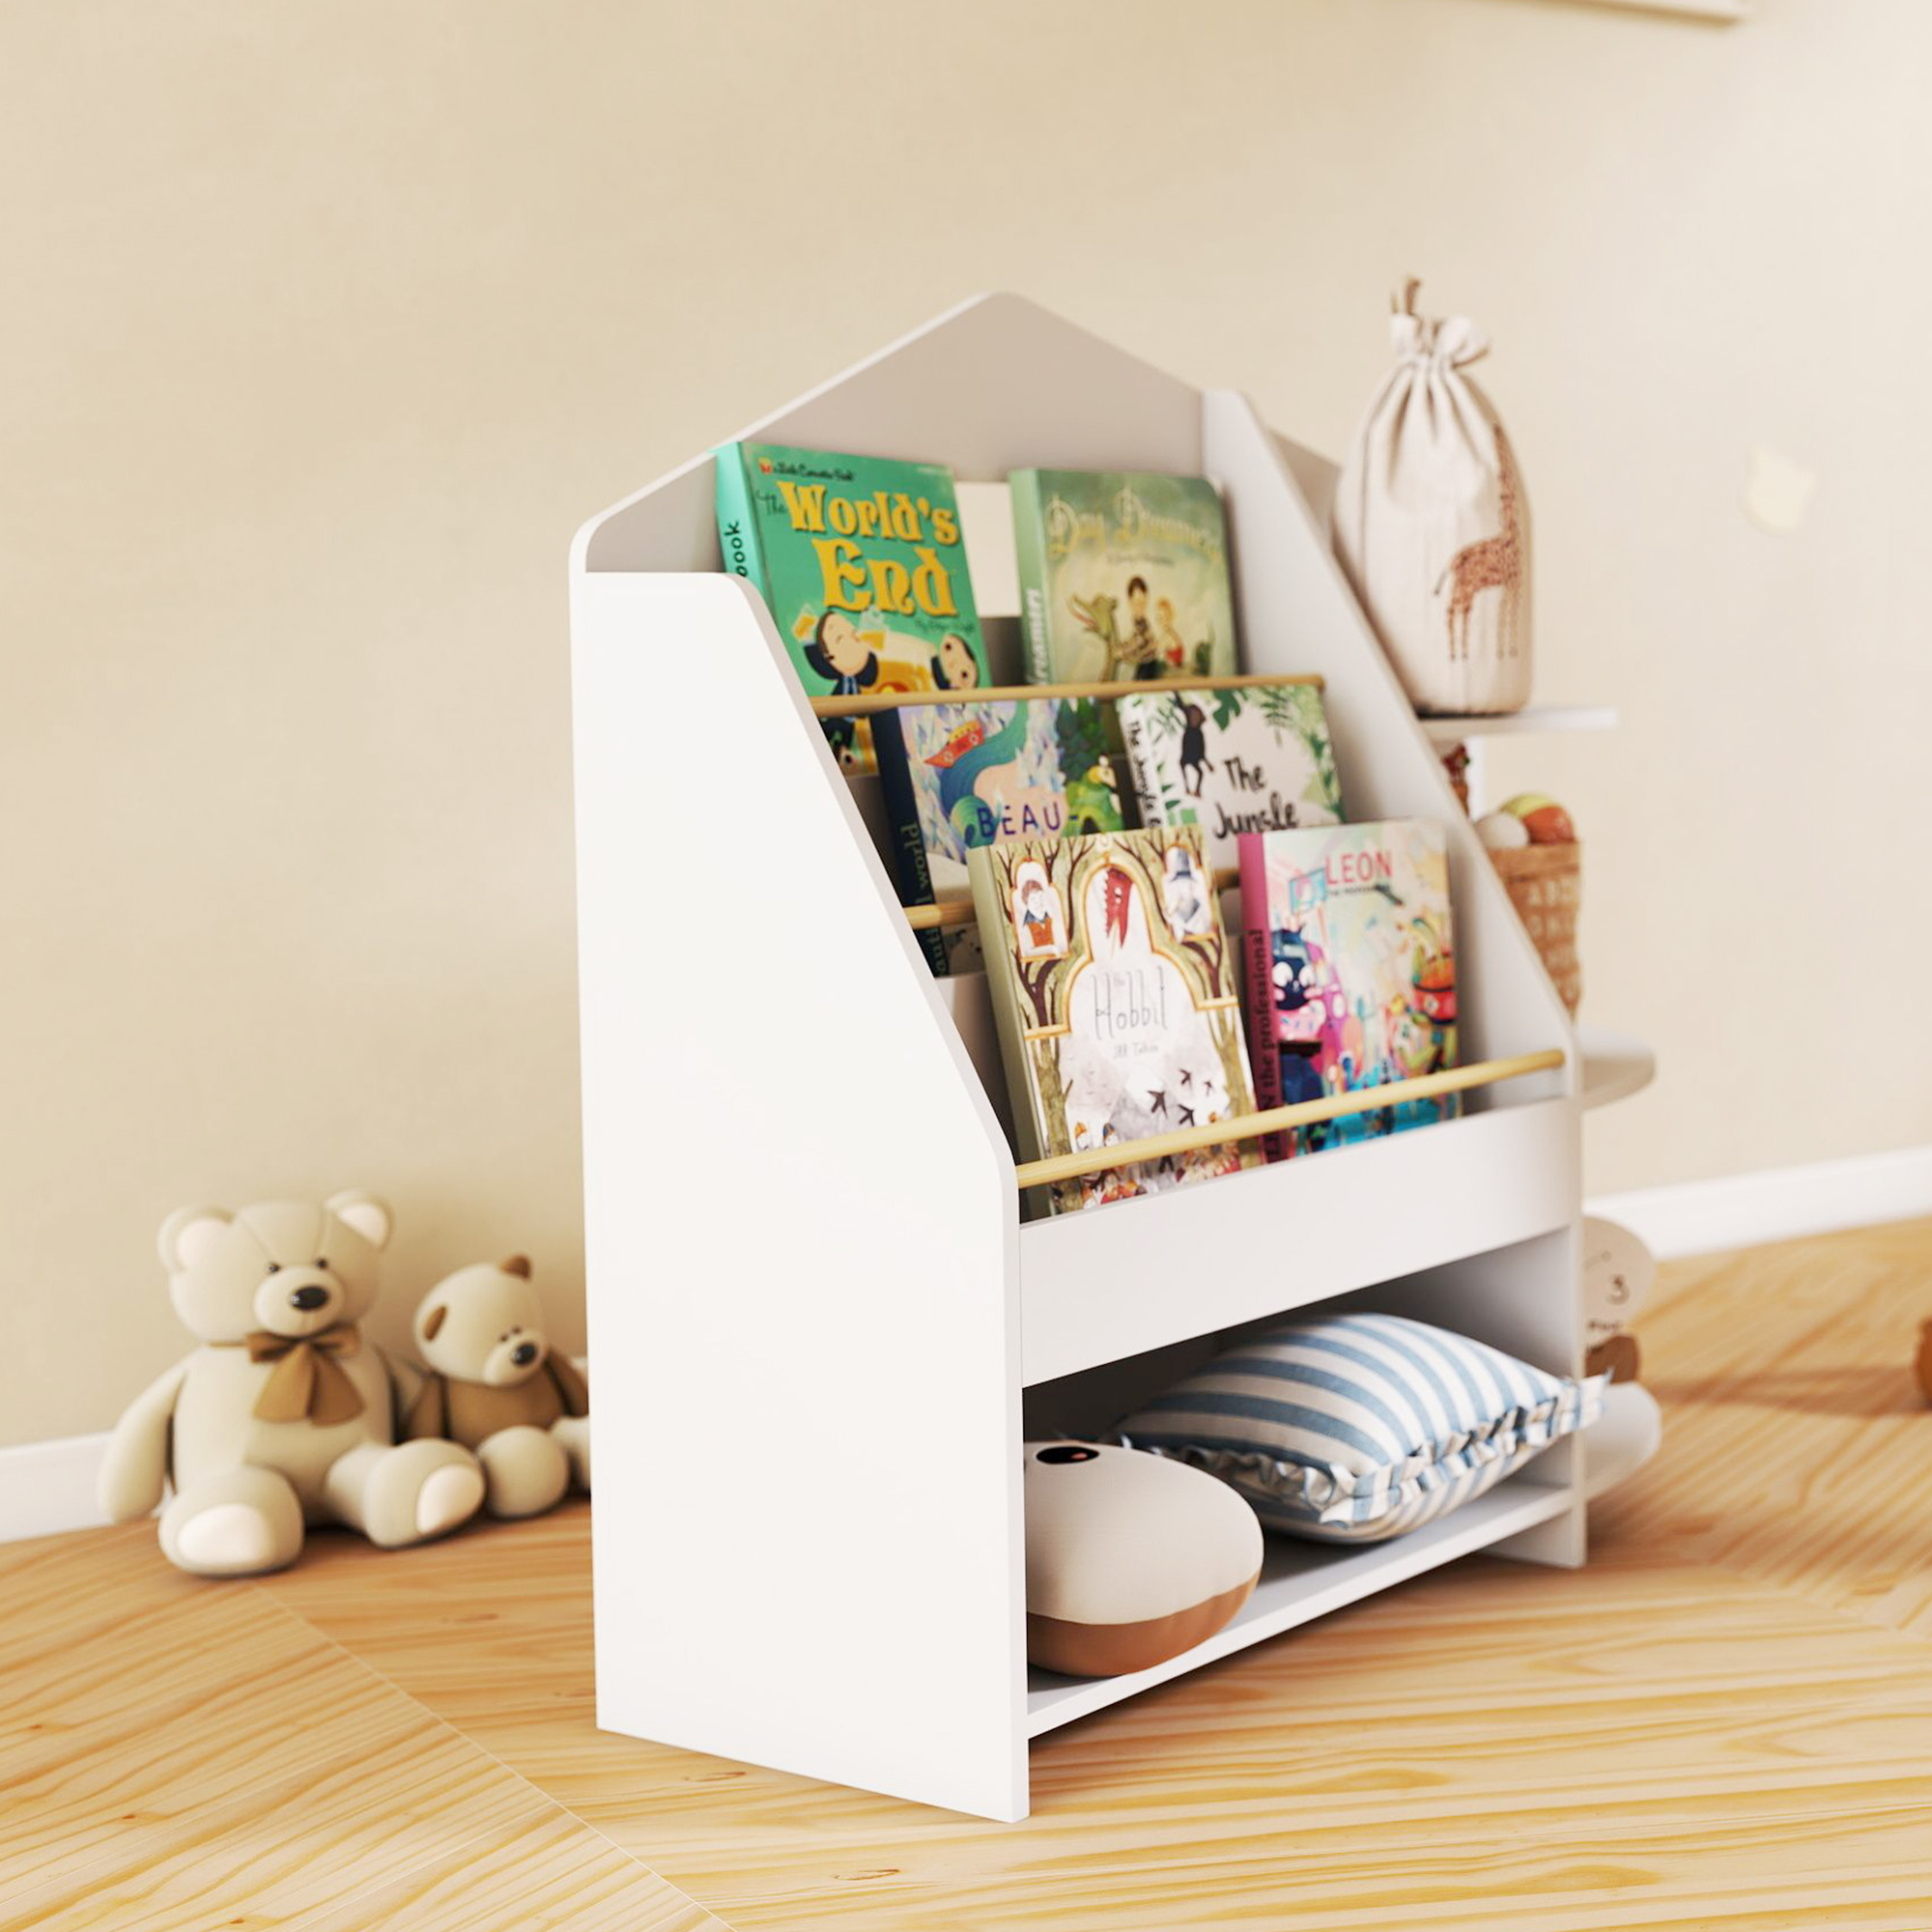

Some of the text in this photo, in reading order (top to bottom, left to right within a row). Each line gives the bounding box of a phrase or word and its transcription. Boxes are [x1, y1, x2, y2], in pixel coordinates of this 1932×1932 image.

[777, 480, 959, 546] World's
[811, 538, 957, 616] End
[1223, 756, 1267, 792] The
[899, 820, 930, 890] world
[1324, 850, 1393, 885] LEON
[1091, 965, 1168, 1040] Hobbit
[1248, 929, 1275, 1050] professional
[1258, 1055, 1274, 1088] the
